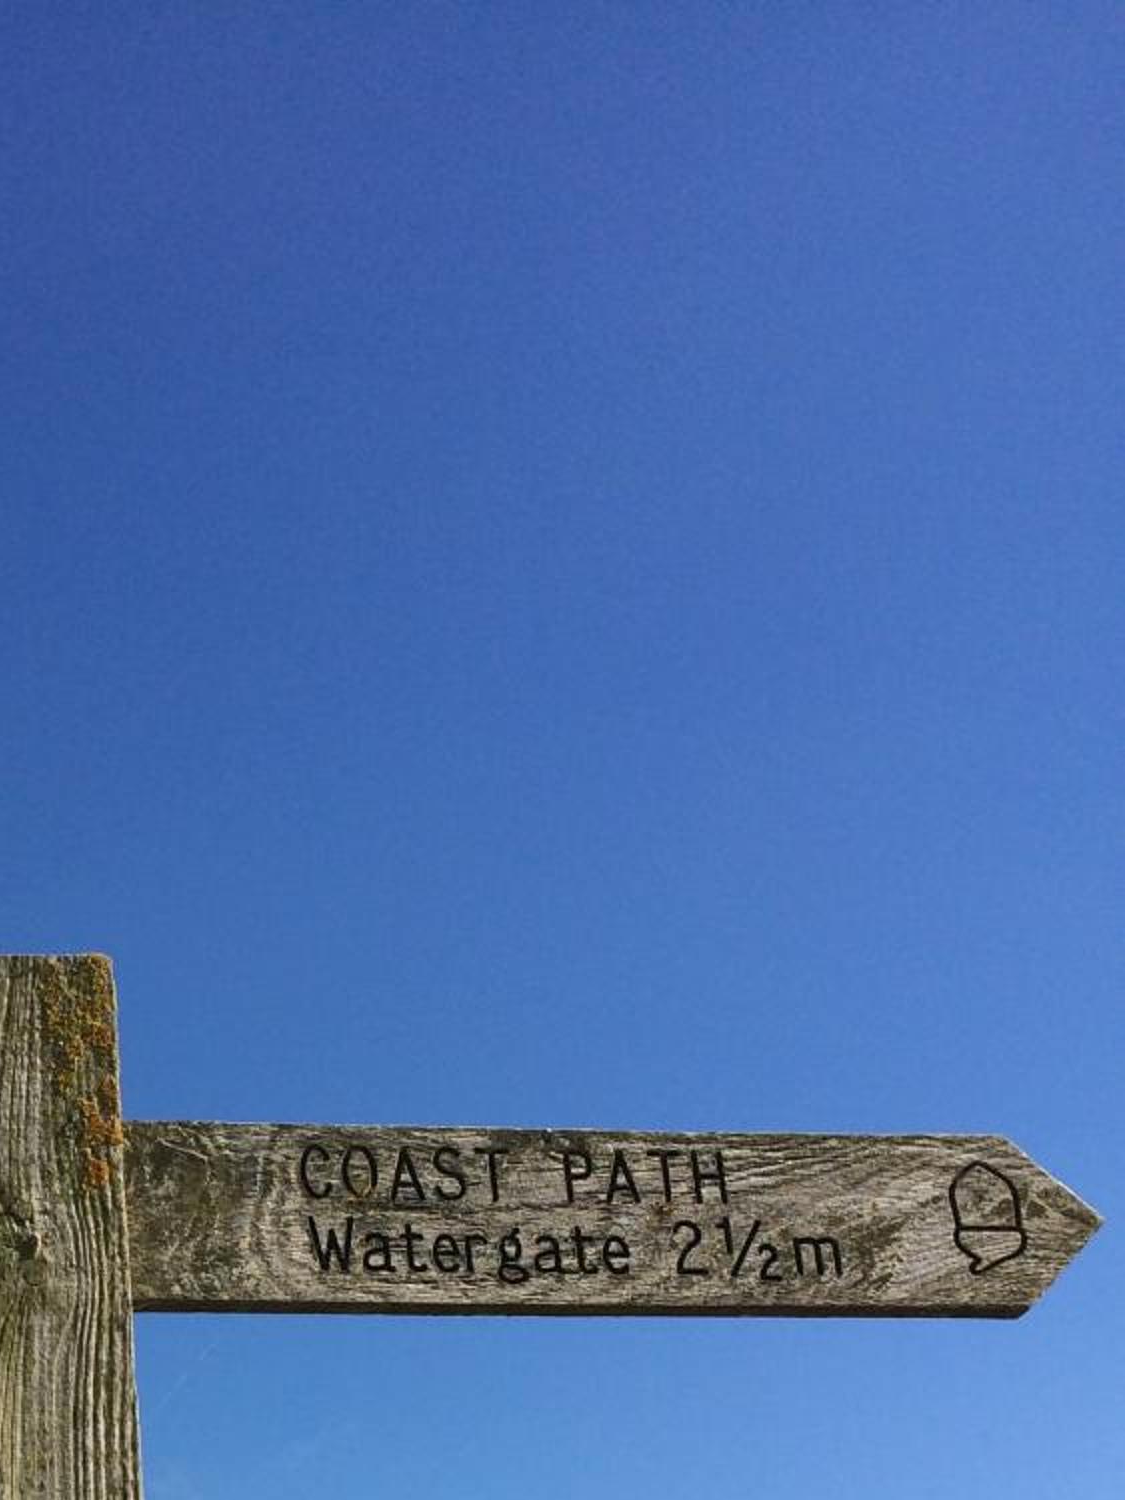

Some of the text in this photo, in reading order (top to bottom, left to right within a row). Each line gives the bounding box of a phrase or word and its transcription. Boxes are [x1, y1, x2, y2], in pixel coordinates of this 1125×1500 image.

[300, 1144, 728, 1203] COAST PATH
[306, 1215, 631, 1284] Watergate
